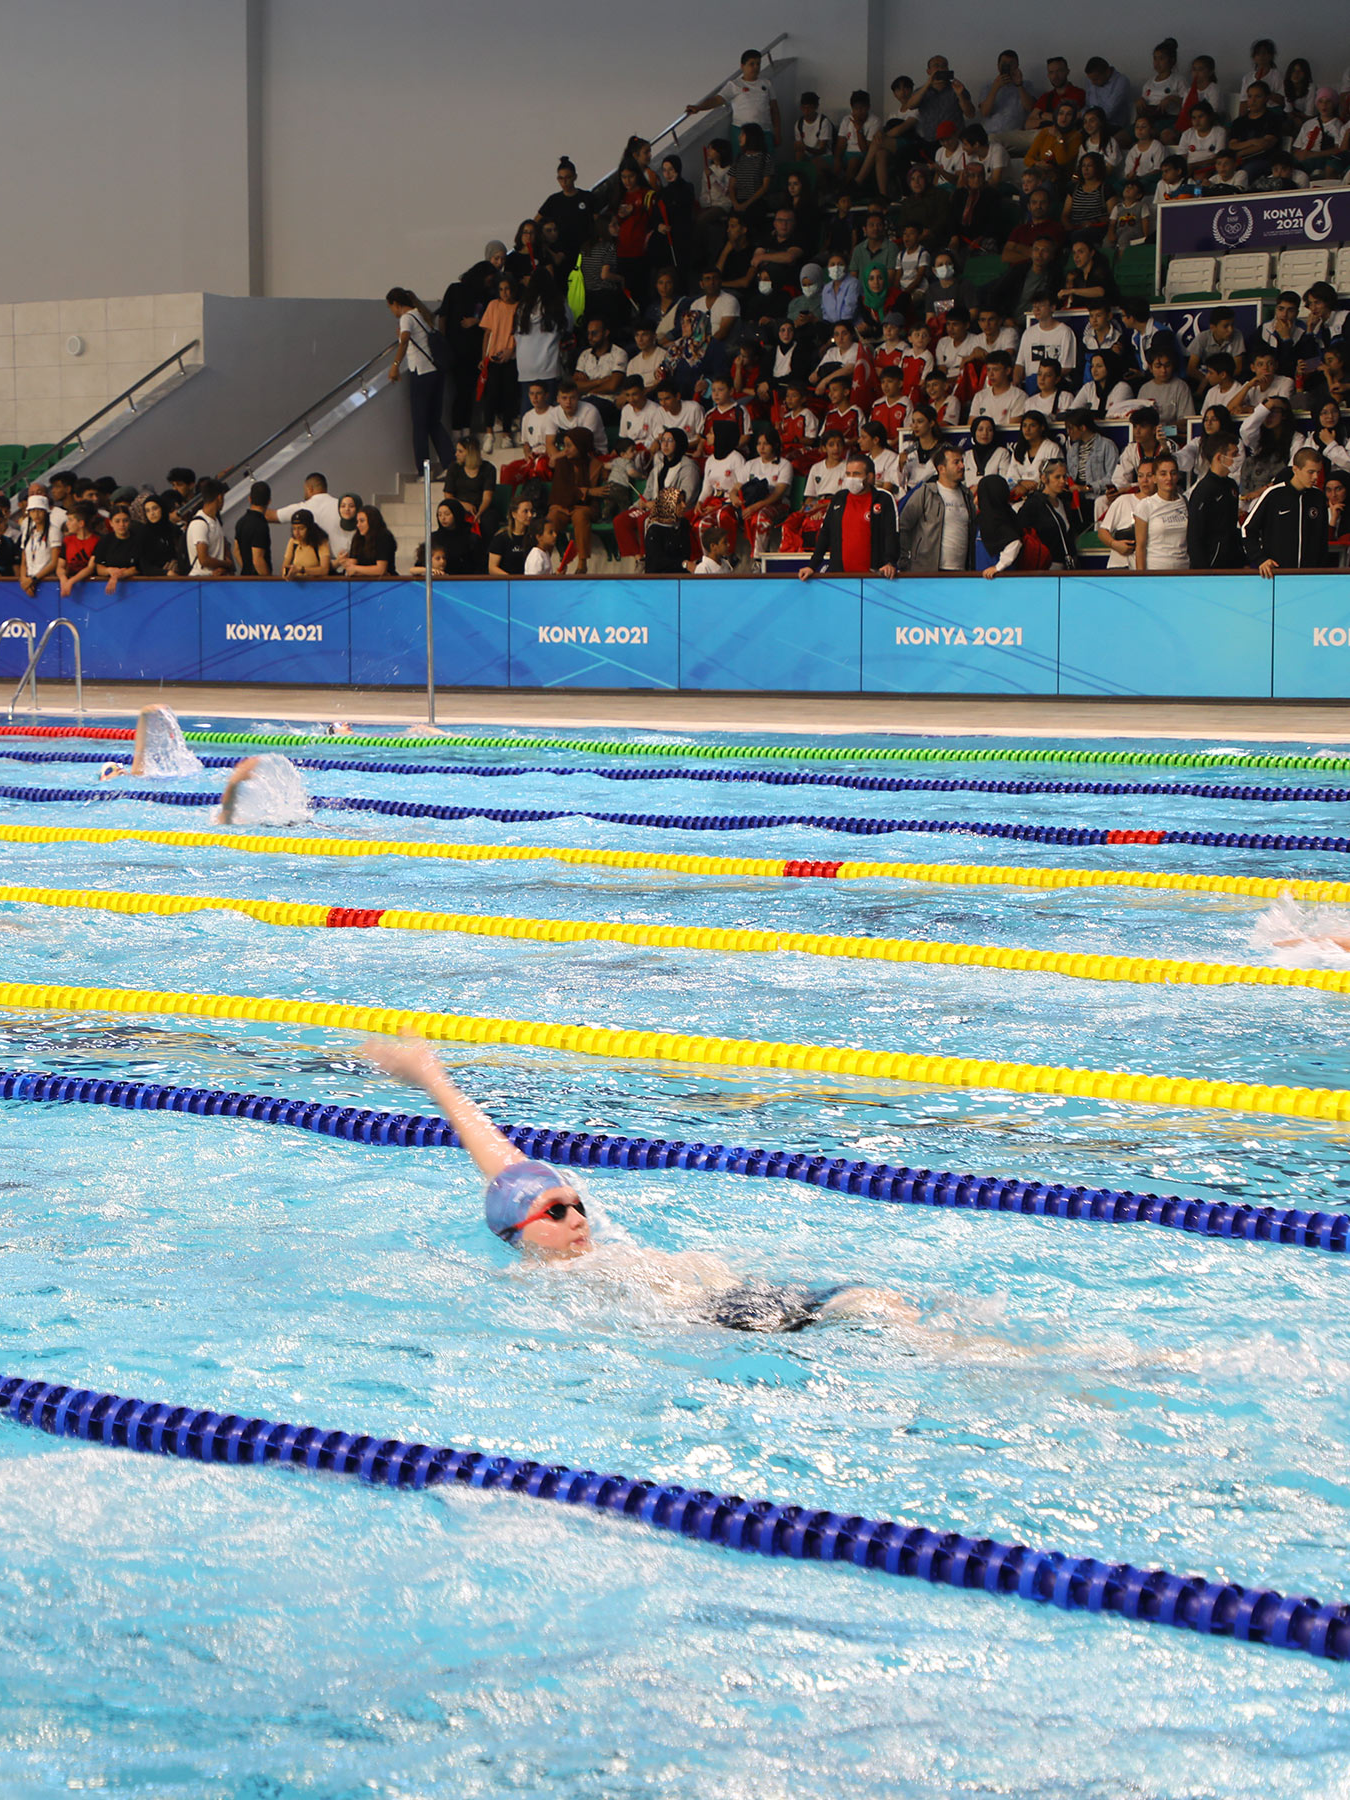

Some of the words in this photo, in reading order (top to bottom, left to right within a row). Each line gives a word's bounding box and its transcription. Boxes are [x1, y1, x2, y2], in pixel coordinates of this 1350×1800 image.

[1263, 208, 1303, 220] KONYA
[1276, 218, 1304, 230] 2021
[226, 624, 281, 640] KONYA
[284, 624, 323, 641] 2021
[538, 626, 601, 643] KONYA
[604, 626, 648, 644] 2021
[896, 627, 968, 645] KONYA
[972, 627, 1023, 646] 2021
[1313, 627, 1350, 647] KO
